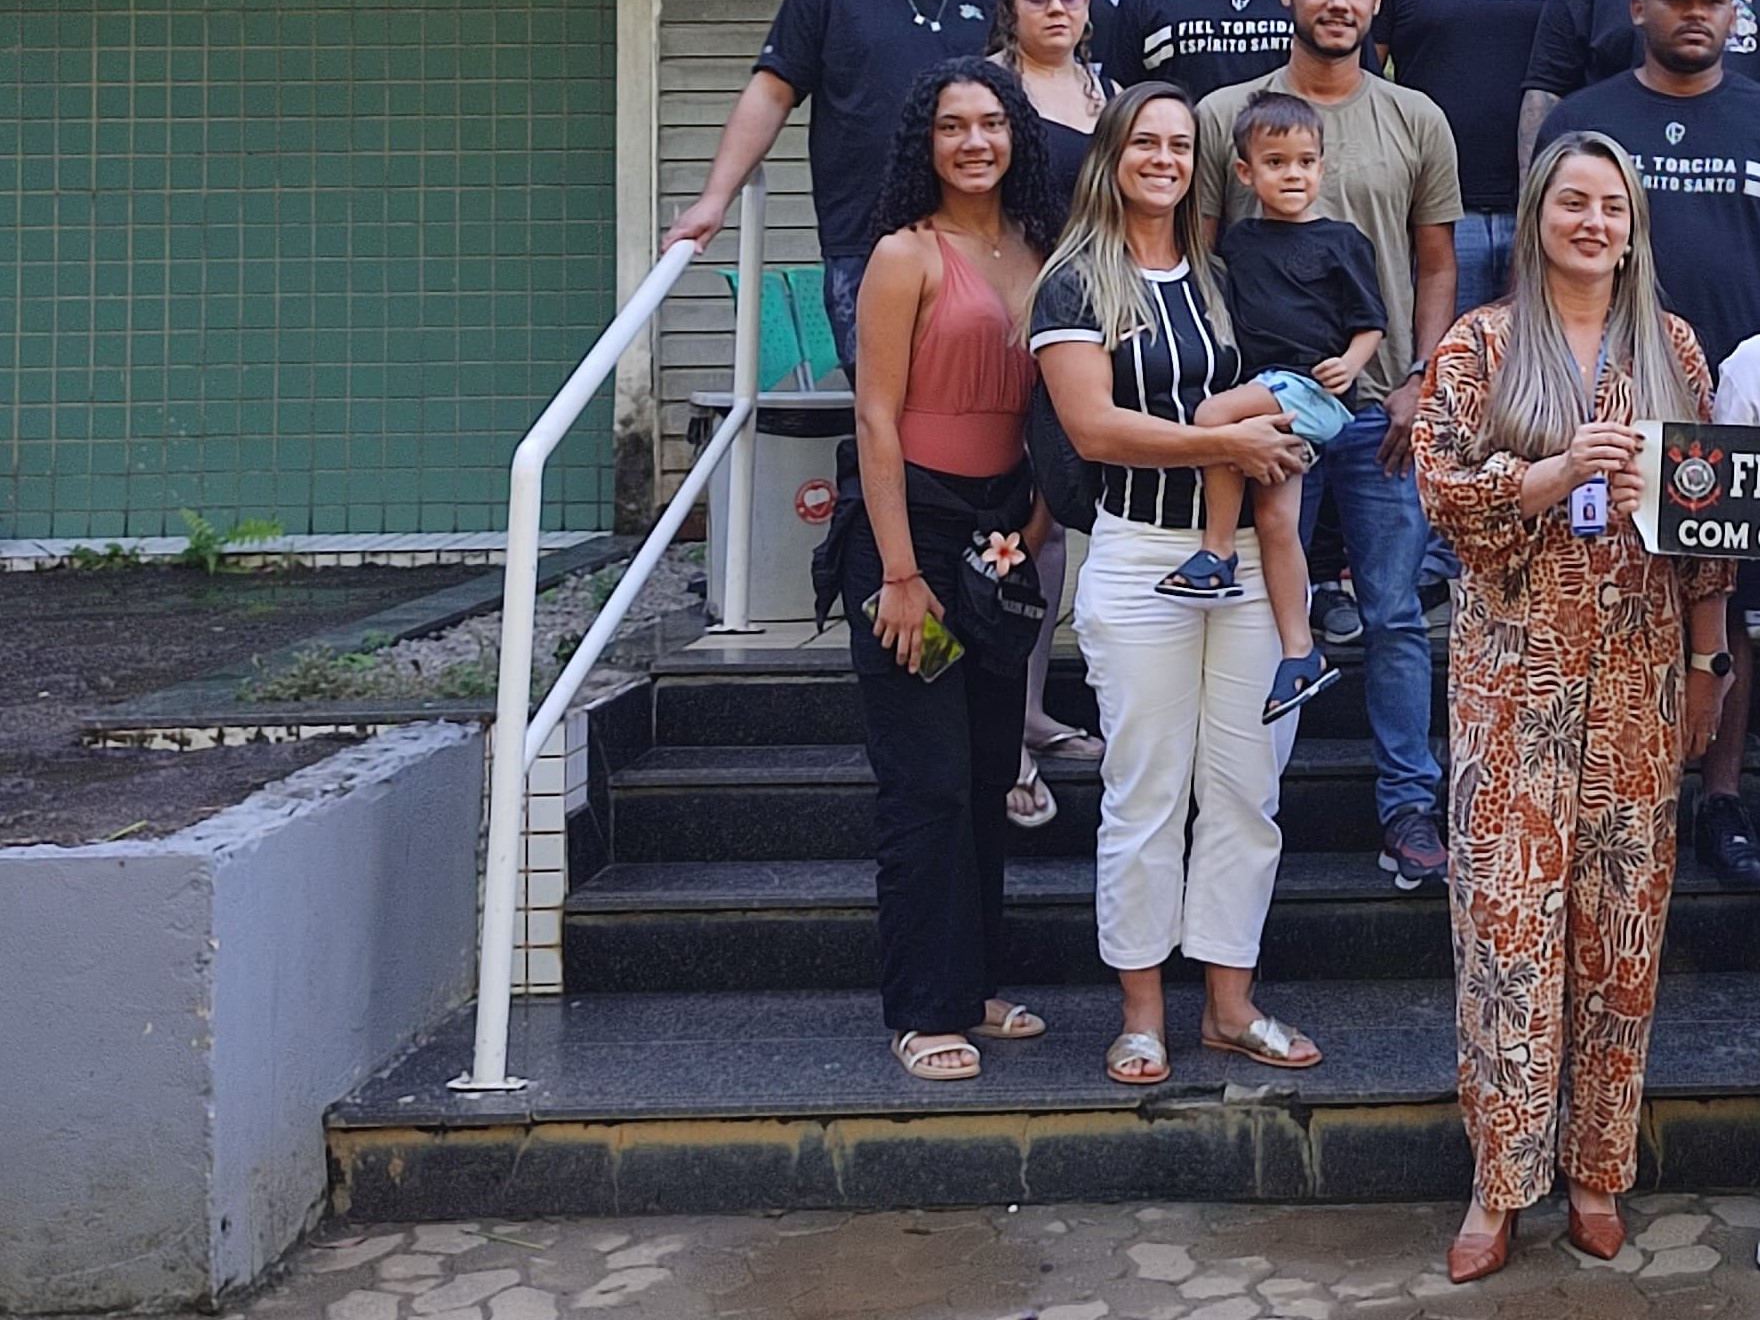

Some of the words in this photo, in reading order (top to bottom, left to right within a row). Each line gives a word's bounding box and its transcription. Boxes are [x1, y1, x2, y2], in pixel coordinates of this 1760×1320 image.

[1177, 16, 1216, 38] FIEL
[1179, 36, 1248, 56] ESPÍRITO
[1250, 36, 1295, 52] SANT
[1653, 155, 1738, 175] TORCIDA
[1642, 174, 1680, 191] RITO
[1682, 177, 1737, 193] SANTO
[1678, 519, 1750, 550] COM
